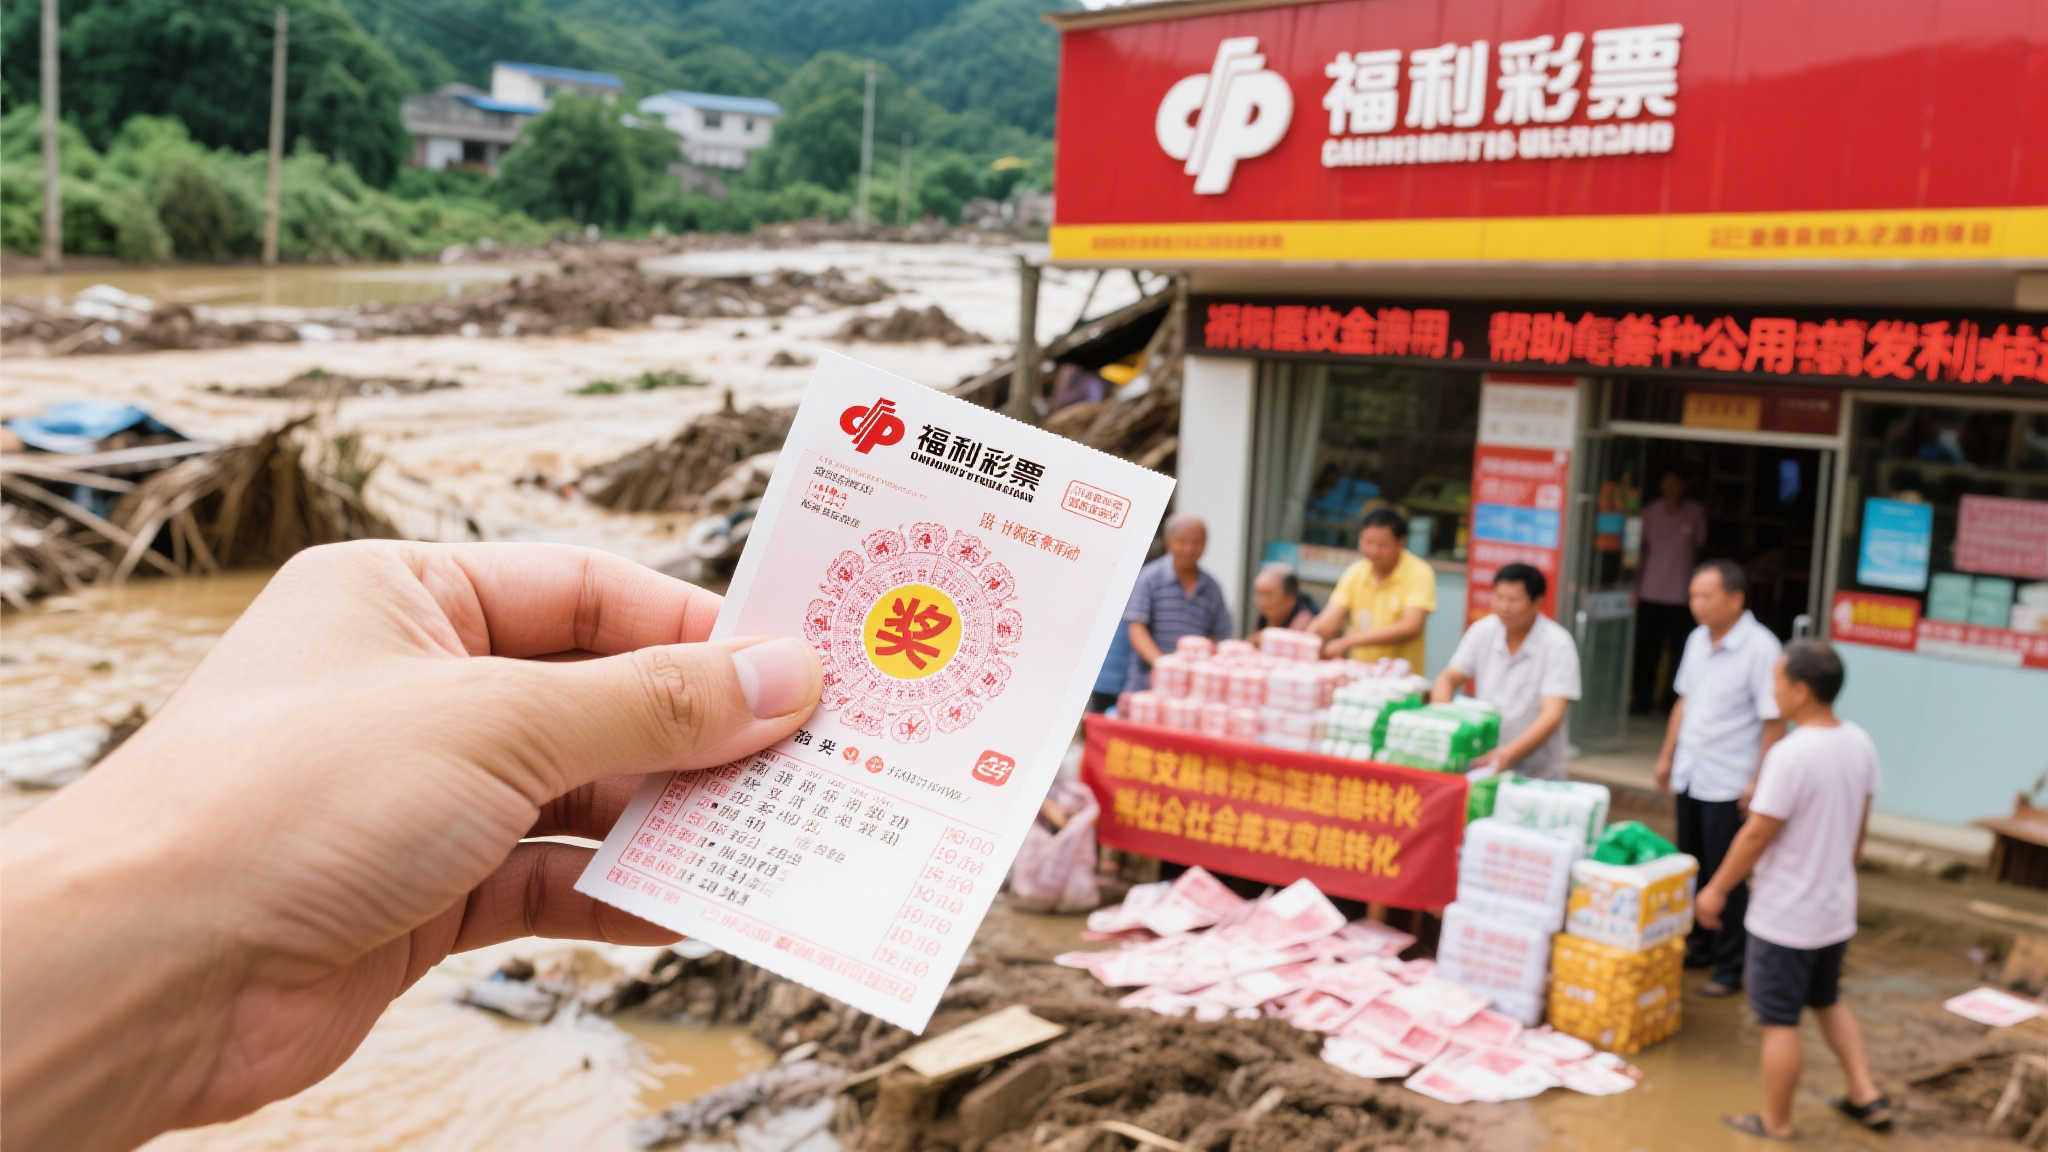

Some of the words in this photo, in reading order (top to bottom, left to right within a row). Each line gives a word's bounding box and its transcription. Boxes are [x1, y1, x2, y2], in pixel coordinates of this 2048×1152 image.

[1321, 22, 1684, 136] 福利彩票
[917, 423, 1047, 492] 福利彩票
[875, 597, 953, 671] 奖
